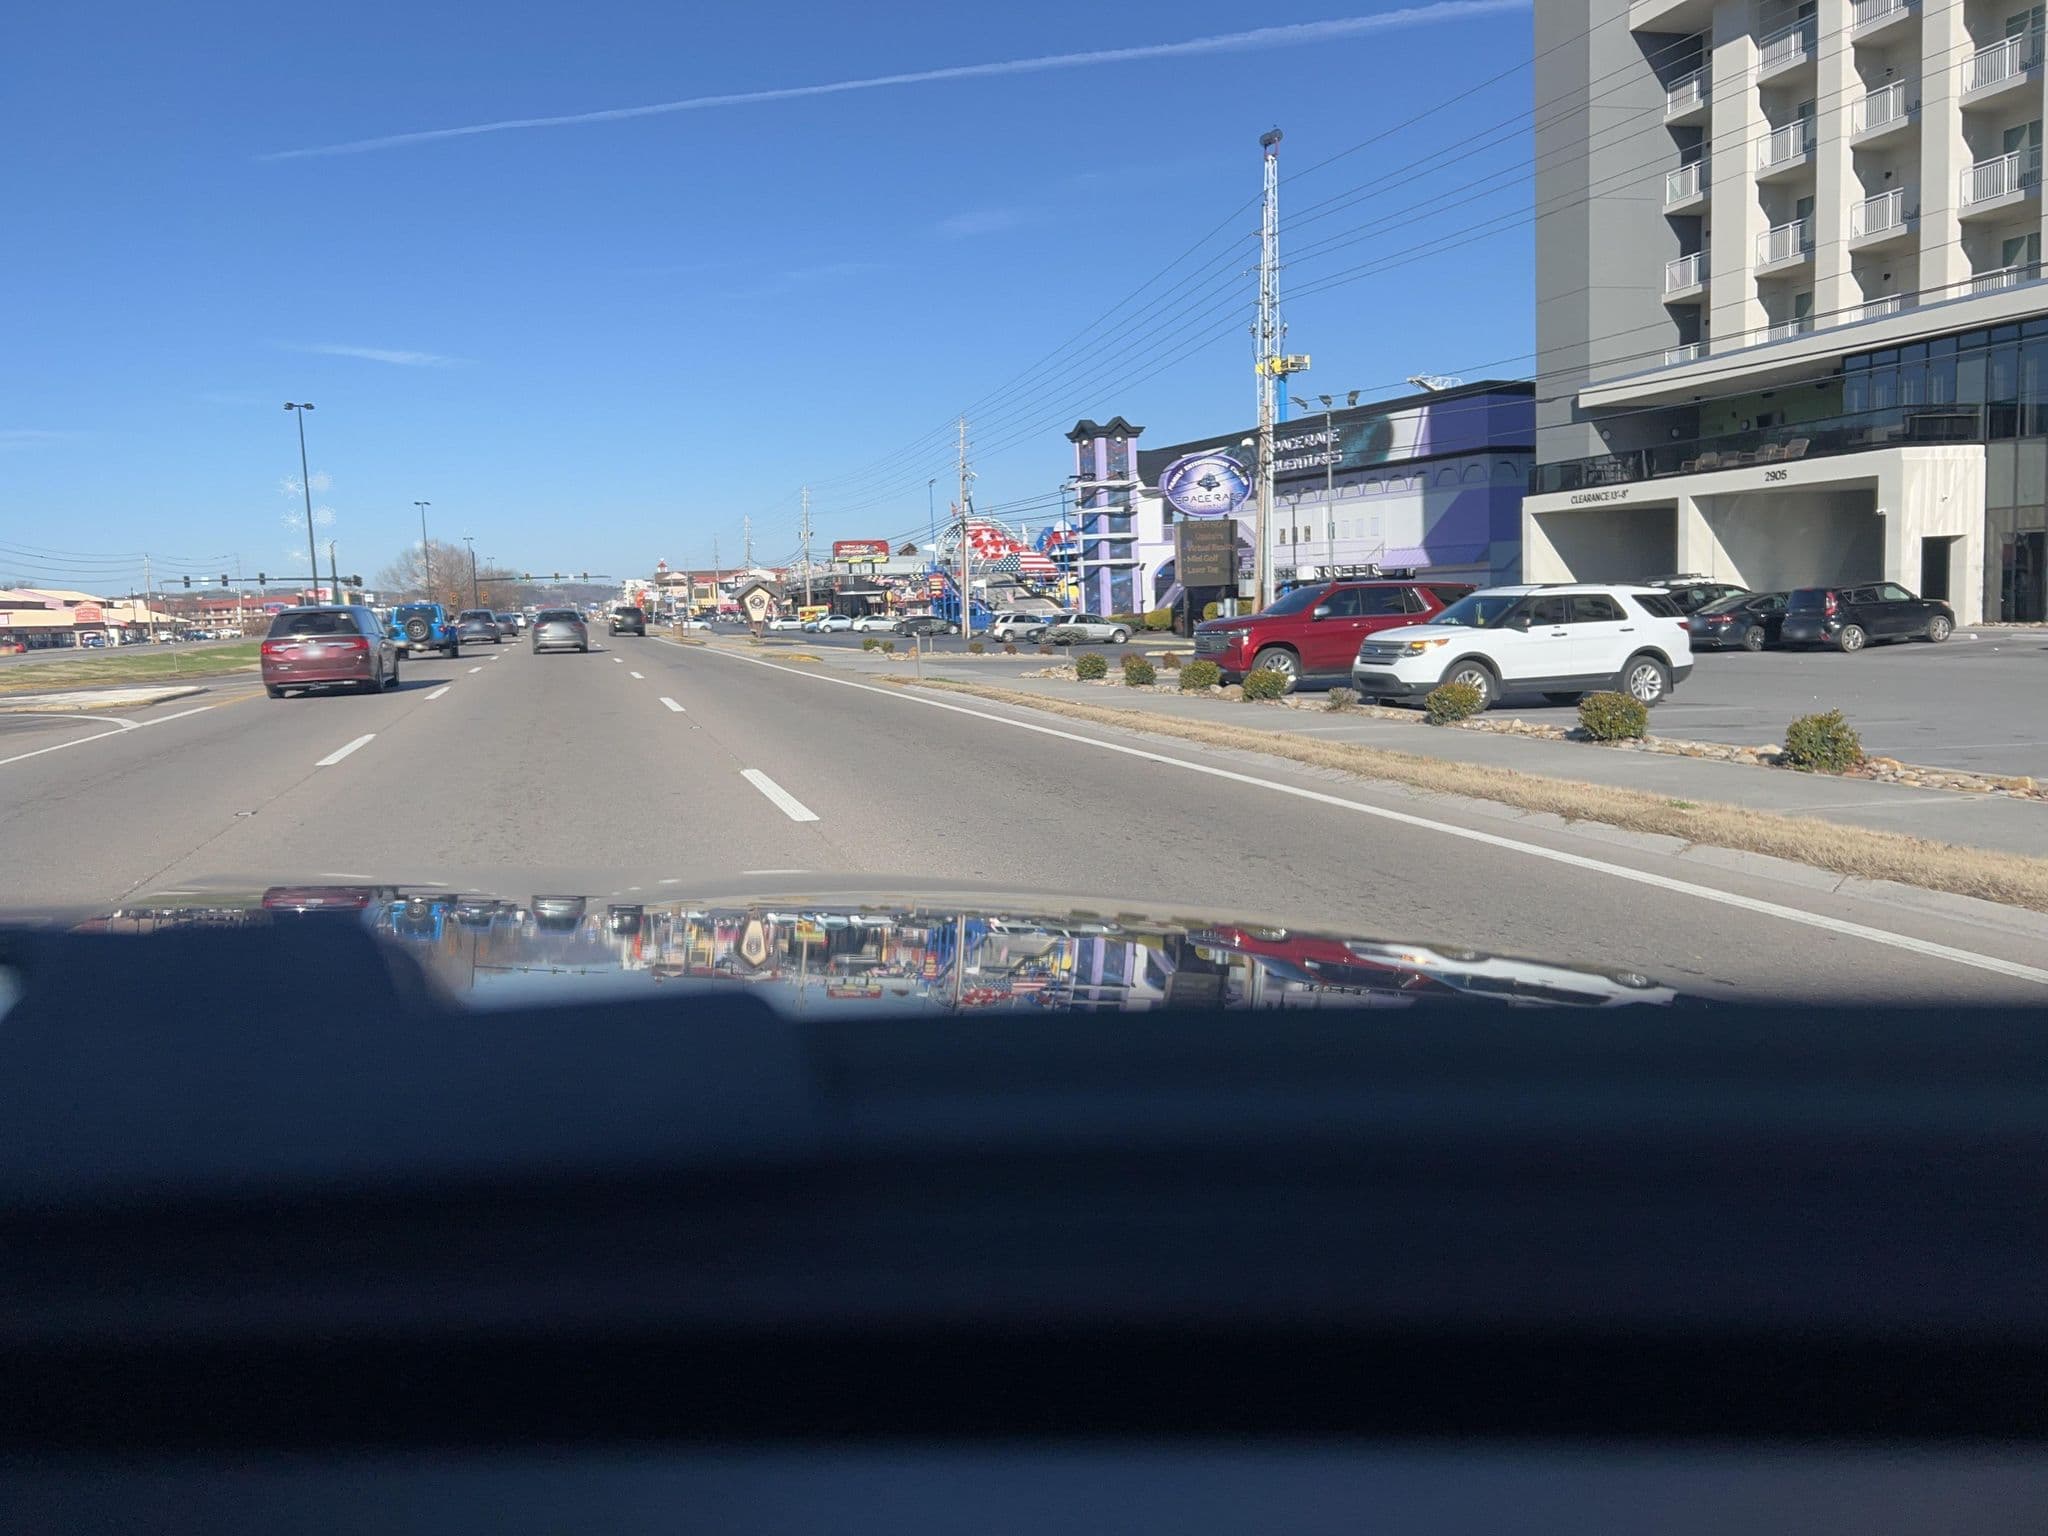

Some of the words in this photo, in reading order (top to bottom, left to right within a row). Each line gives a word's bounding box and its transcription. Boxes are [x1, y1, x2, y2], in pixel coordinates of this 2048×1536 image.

[1272, 435, 1304, 453] PACE
[1765, 469, 1787, 481] 2905
[1175, 494, 1211, 505] SPACE
[1570, 491, 1610, 504] CLEARANCE
